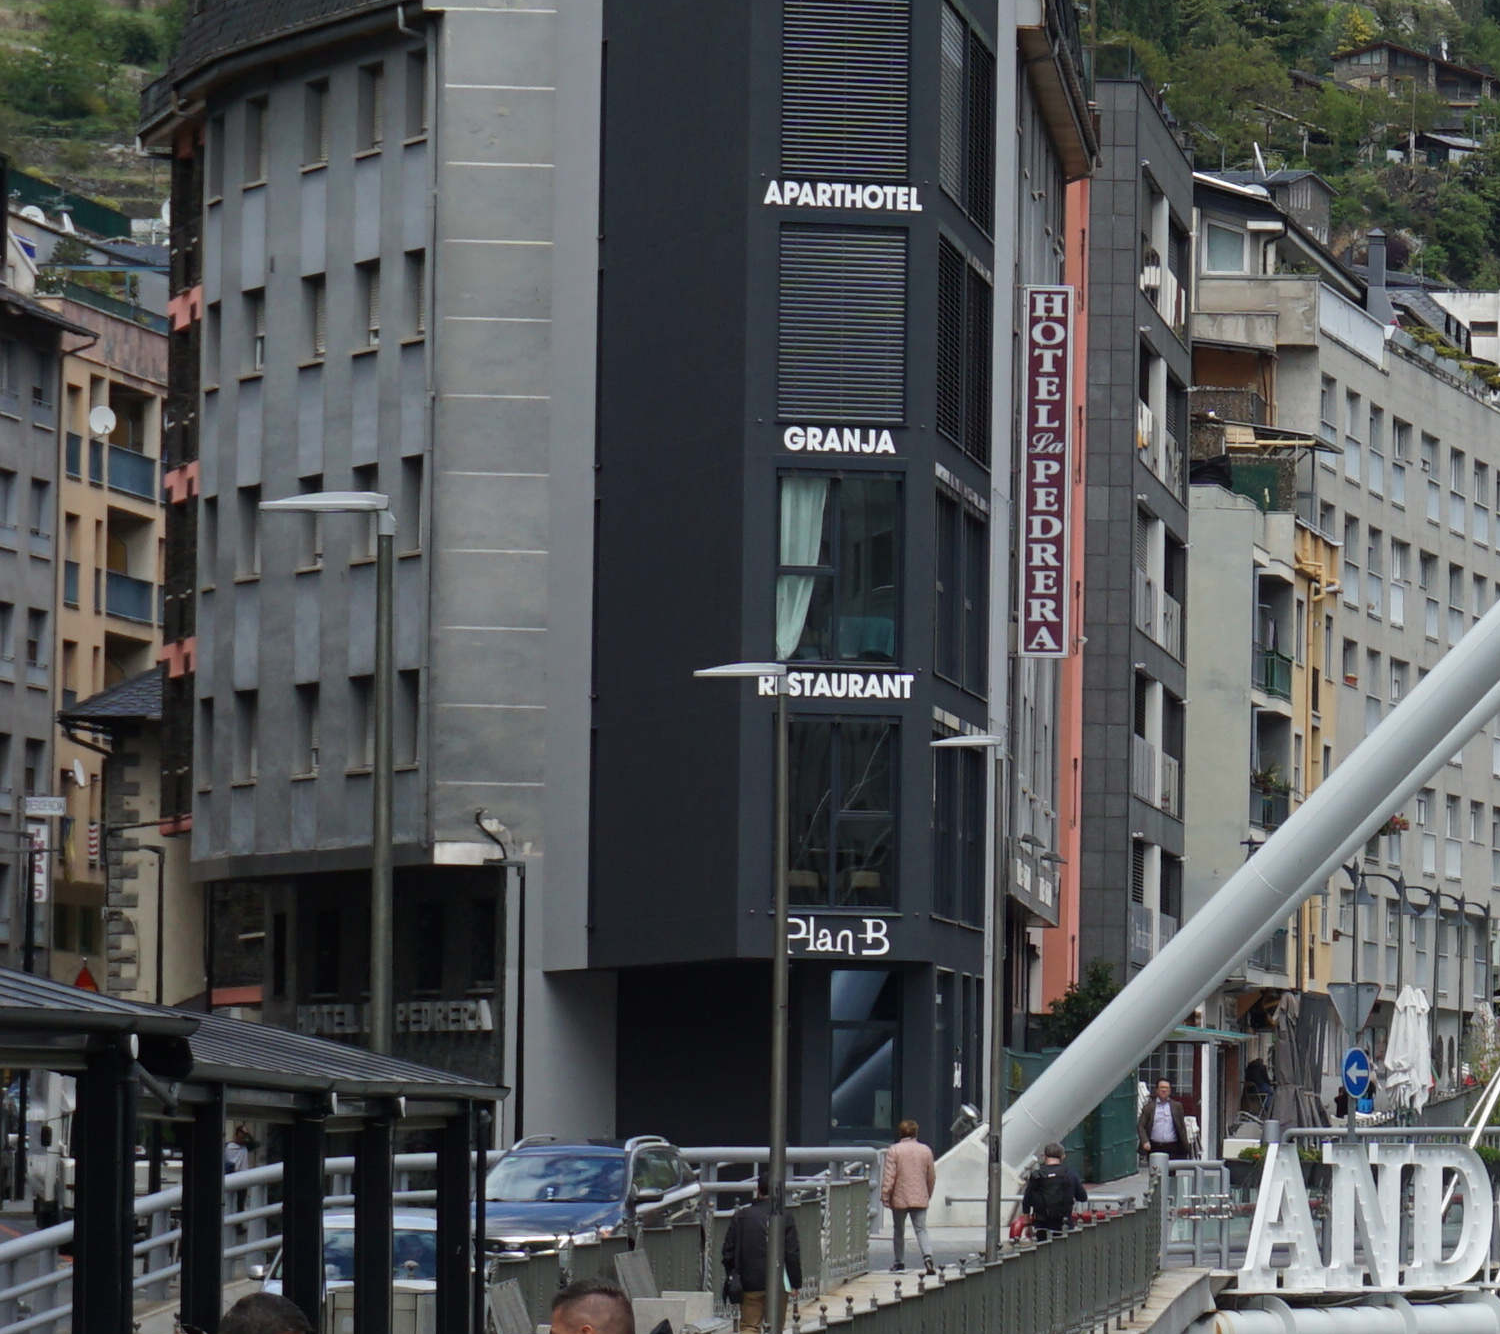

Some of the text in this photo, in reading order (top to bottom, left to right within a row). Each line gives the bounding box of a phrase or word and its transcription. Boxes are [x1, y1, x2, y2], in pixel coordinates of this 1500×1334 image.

[764, 180, 922, 211] APARTHOTEL
[784, 426, 896, 454] GRANJA
[1027, 293, 1066, 650] HOTEL La PEDRERA
[857, 918, 890, 956] B
